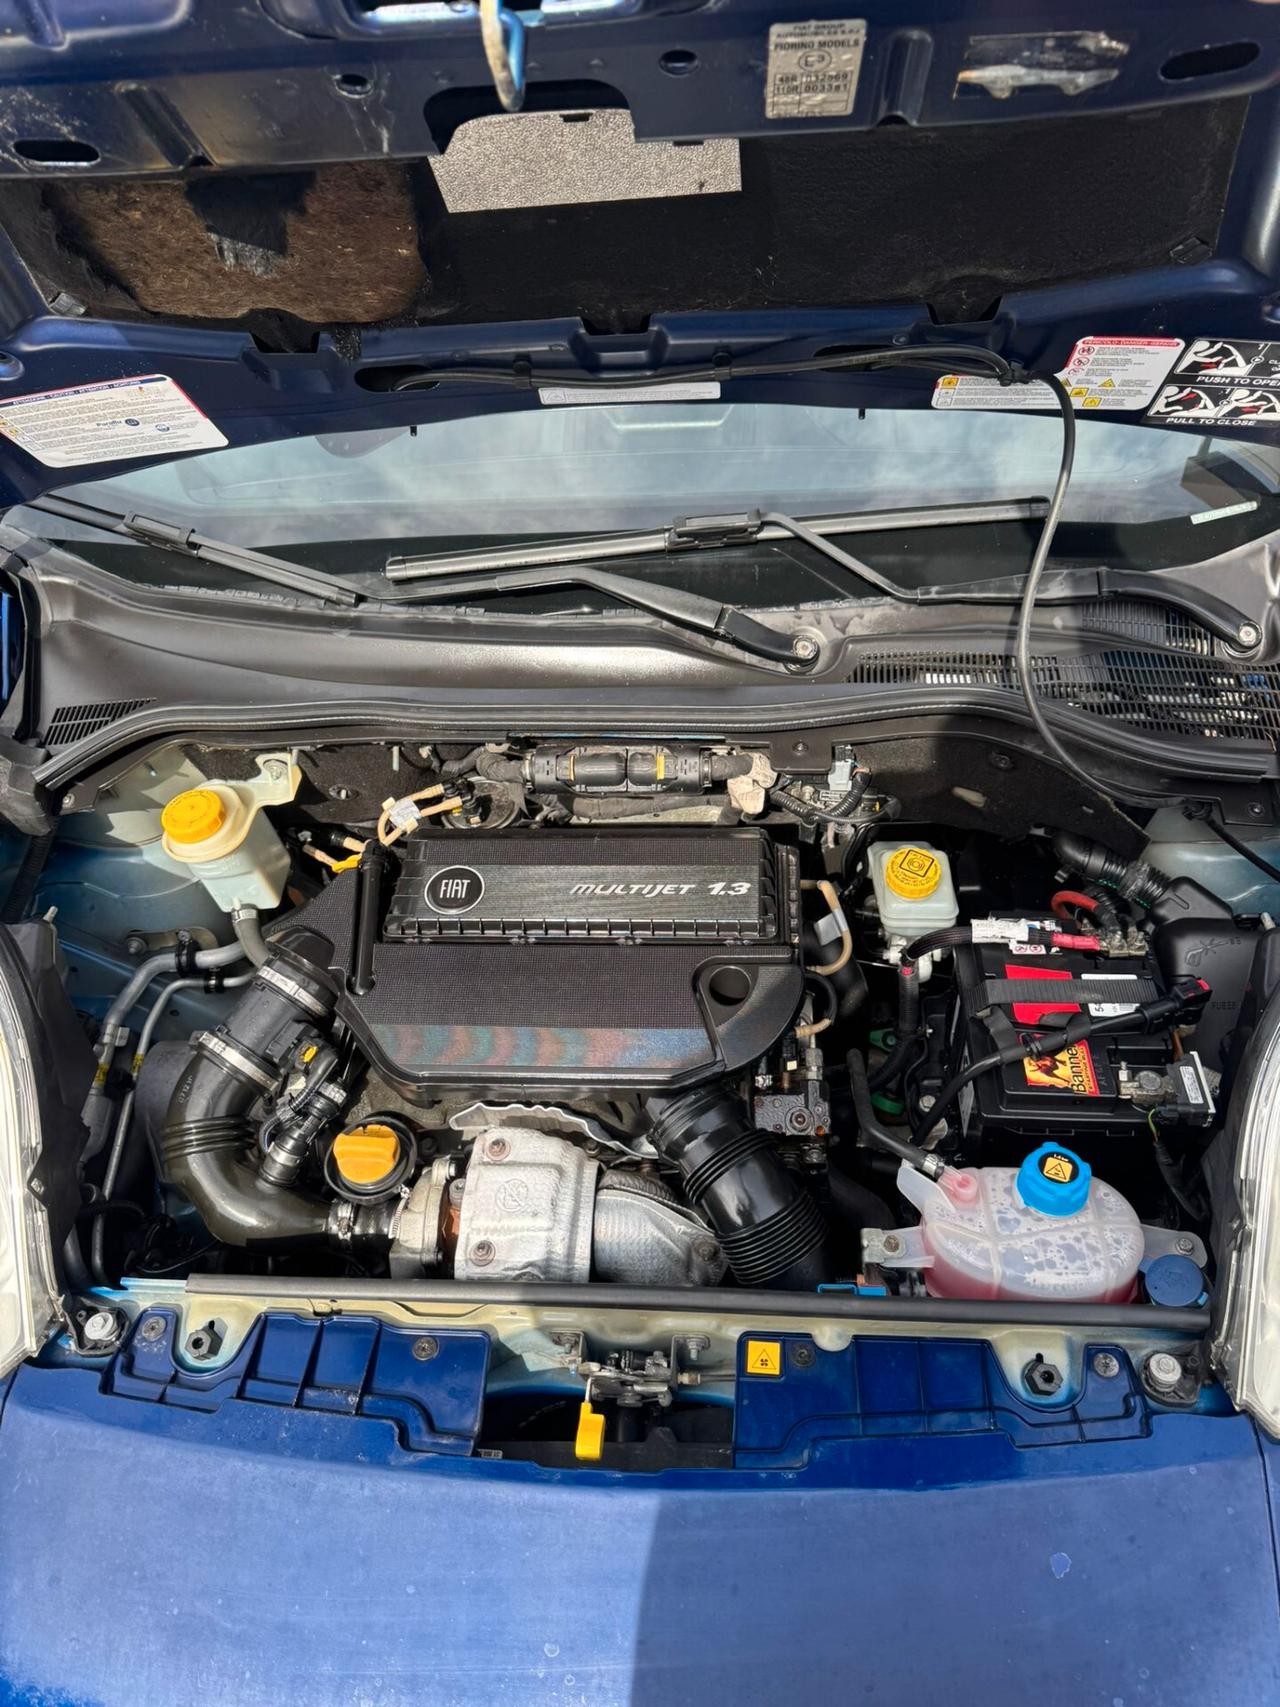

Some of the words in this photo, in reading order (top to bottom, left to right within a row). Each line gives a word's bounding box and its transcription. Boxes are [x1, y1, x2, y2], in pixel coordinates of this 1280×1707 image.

[817, 39, 860, 49] MODELS
[1196, 375, 1231, 385] PUSH
[1233, 377, 1251, 386] TO
[1165, 416, 1196, 424] PULL
[1199, 417, 1216, 425] TO
[1216, 418, 1257, 426] CLOSE
[439, 879, 471, 899] FIAT
[569, 883, 697, 898] MULTIJET
[707, 881, 751, 896] 1.3
[1067, 1044, 1087, 1096] Banne
